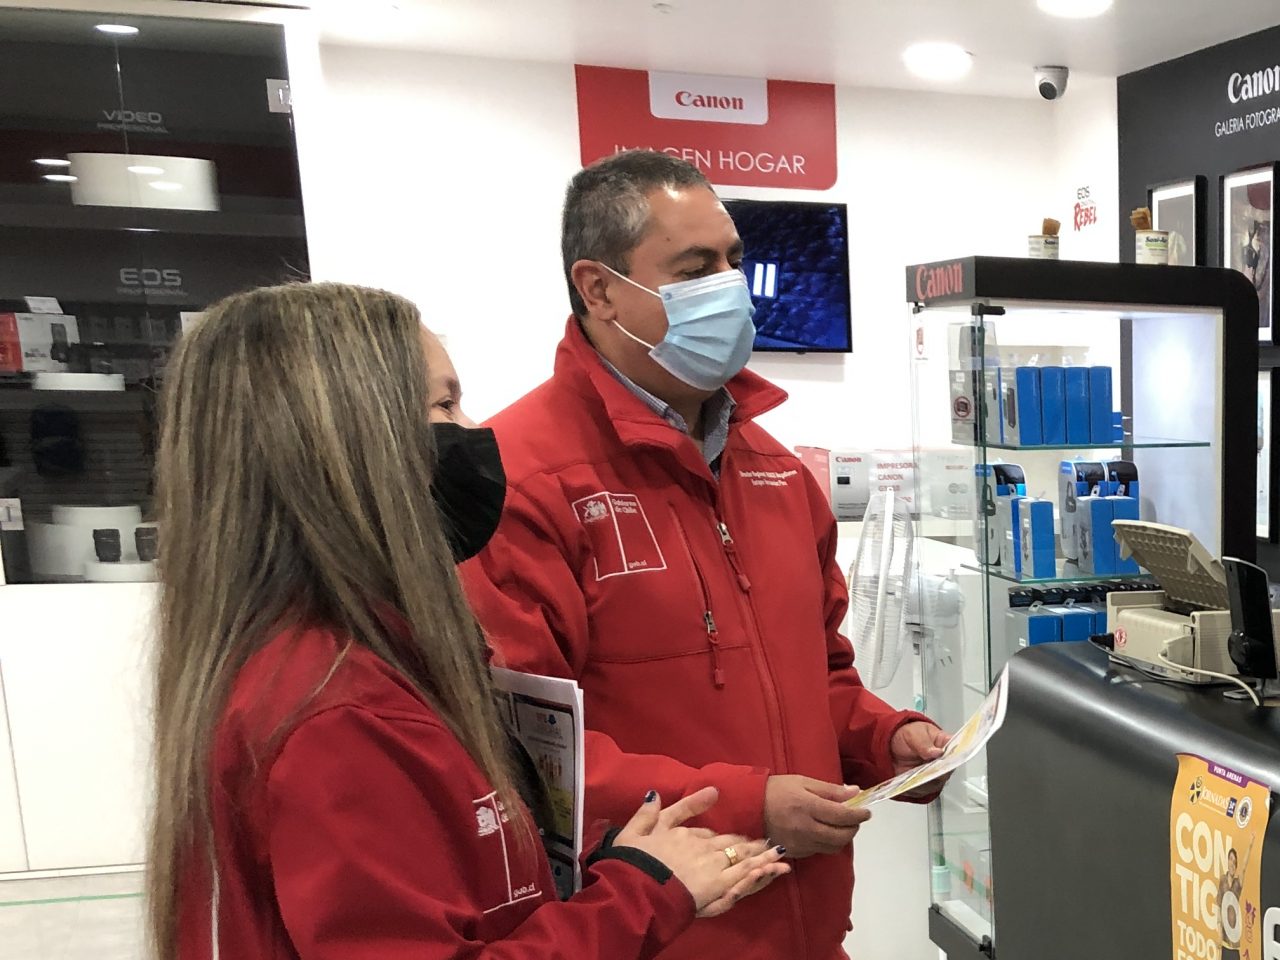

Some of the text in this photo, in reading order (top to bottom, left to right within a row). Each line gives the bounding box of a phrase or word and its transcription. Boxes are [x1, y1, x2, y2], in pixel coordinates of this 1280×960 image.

[675, 90, 745, 111] Canon
[102, 109, 163, 124] VIDEO
[1214, 117, 1244, 137] GALERIA
[719, 150, 805, 175] HOGAR
[119, 267, 182, 287] EOS
[915, 261, 965, 301] Canon
[835, 456, 862, 464] Canon
[877, 462, 918, 470] IMPRESORA
[878, 473, 904, 481] CANON
[1175, 812, 1233, 880] CON
[1175, 862, 1243, 944] TIGO
